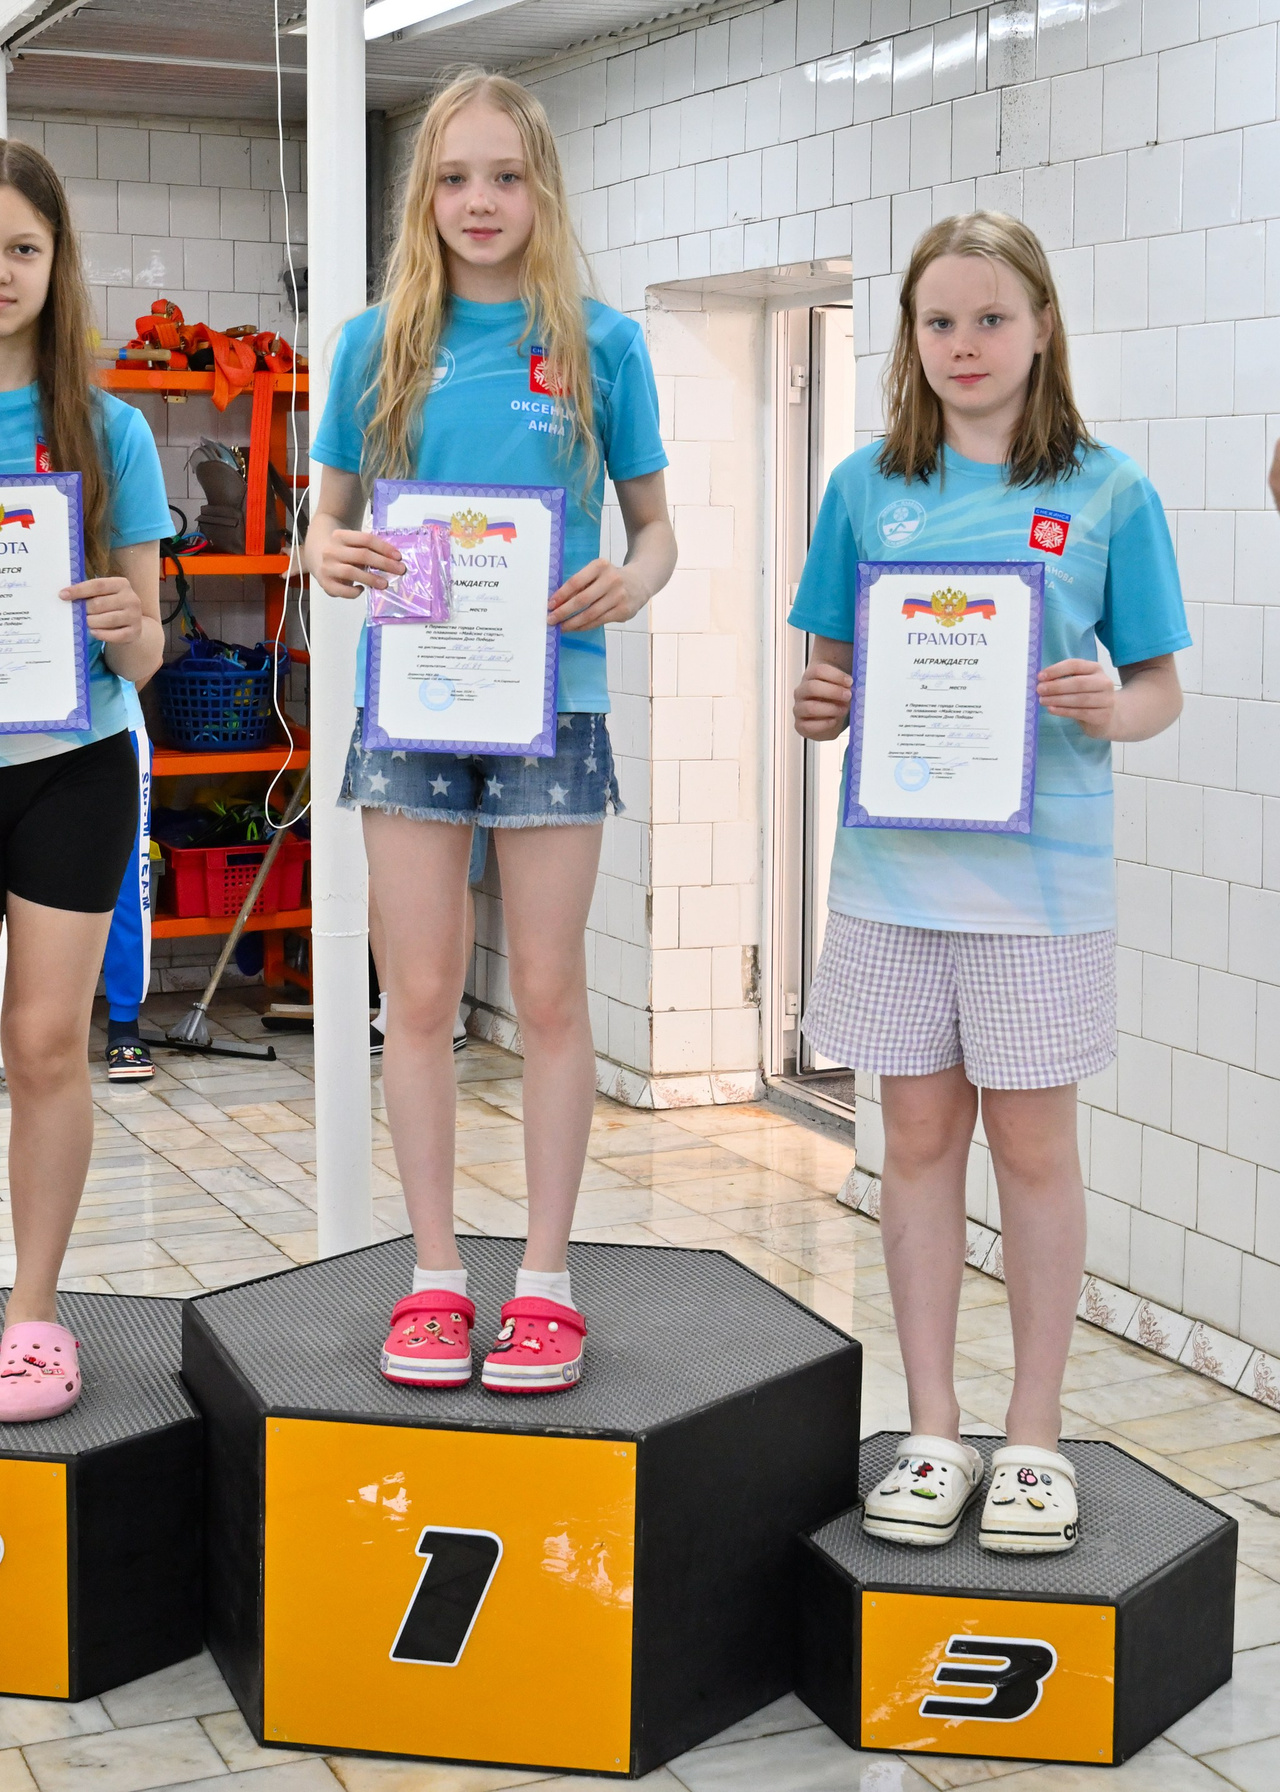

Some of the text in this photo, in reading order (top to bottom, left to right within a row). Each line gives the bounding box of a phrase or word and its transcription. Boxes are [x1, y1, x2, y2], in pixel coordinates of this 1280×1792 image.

[528, 419, 565, 436] АННА
[451, 554, 508, 569] АМОТА
[907, 632, 988, 646] ГРАМОТА
[913, 658, 979, 666] НАГРАЖДАЕТСЯ
[140, 771, 151, 911] SWM TEAM
[388, 1524, 504, 1668] 1
[918, 1634, 1058, 1723] 3
